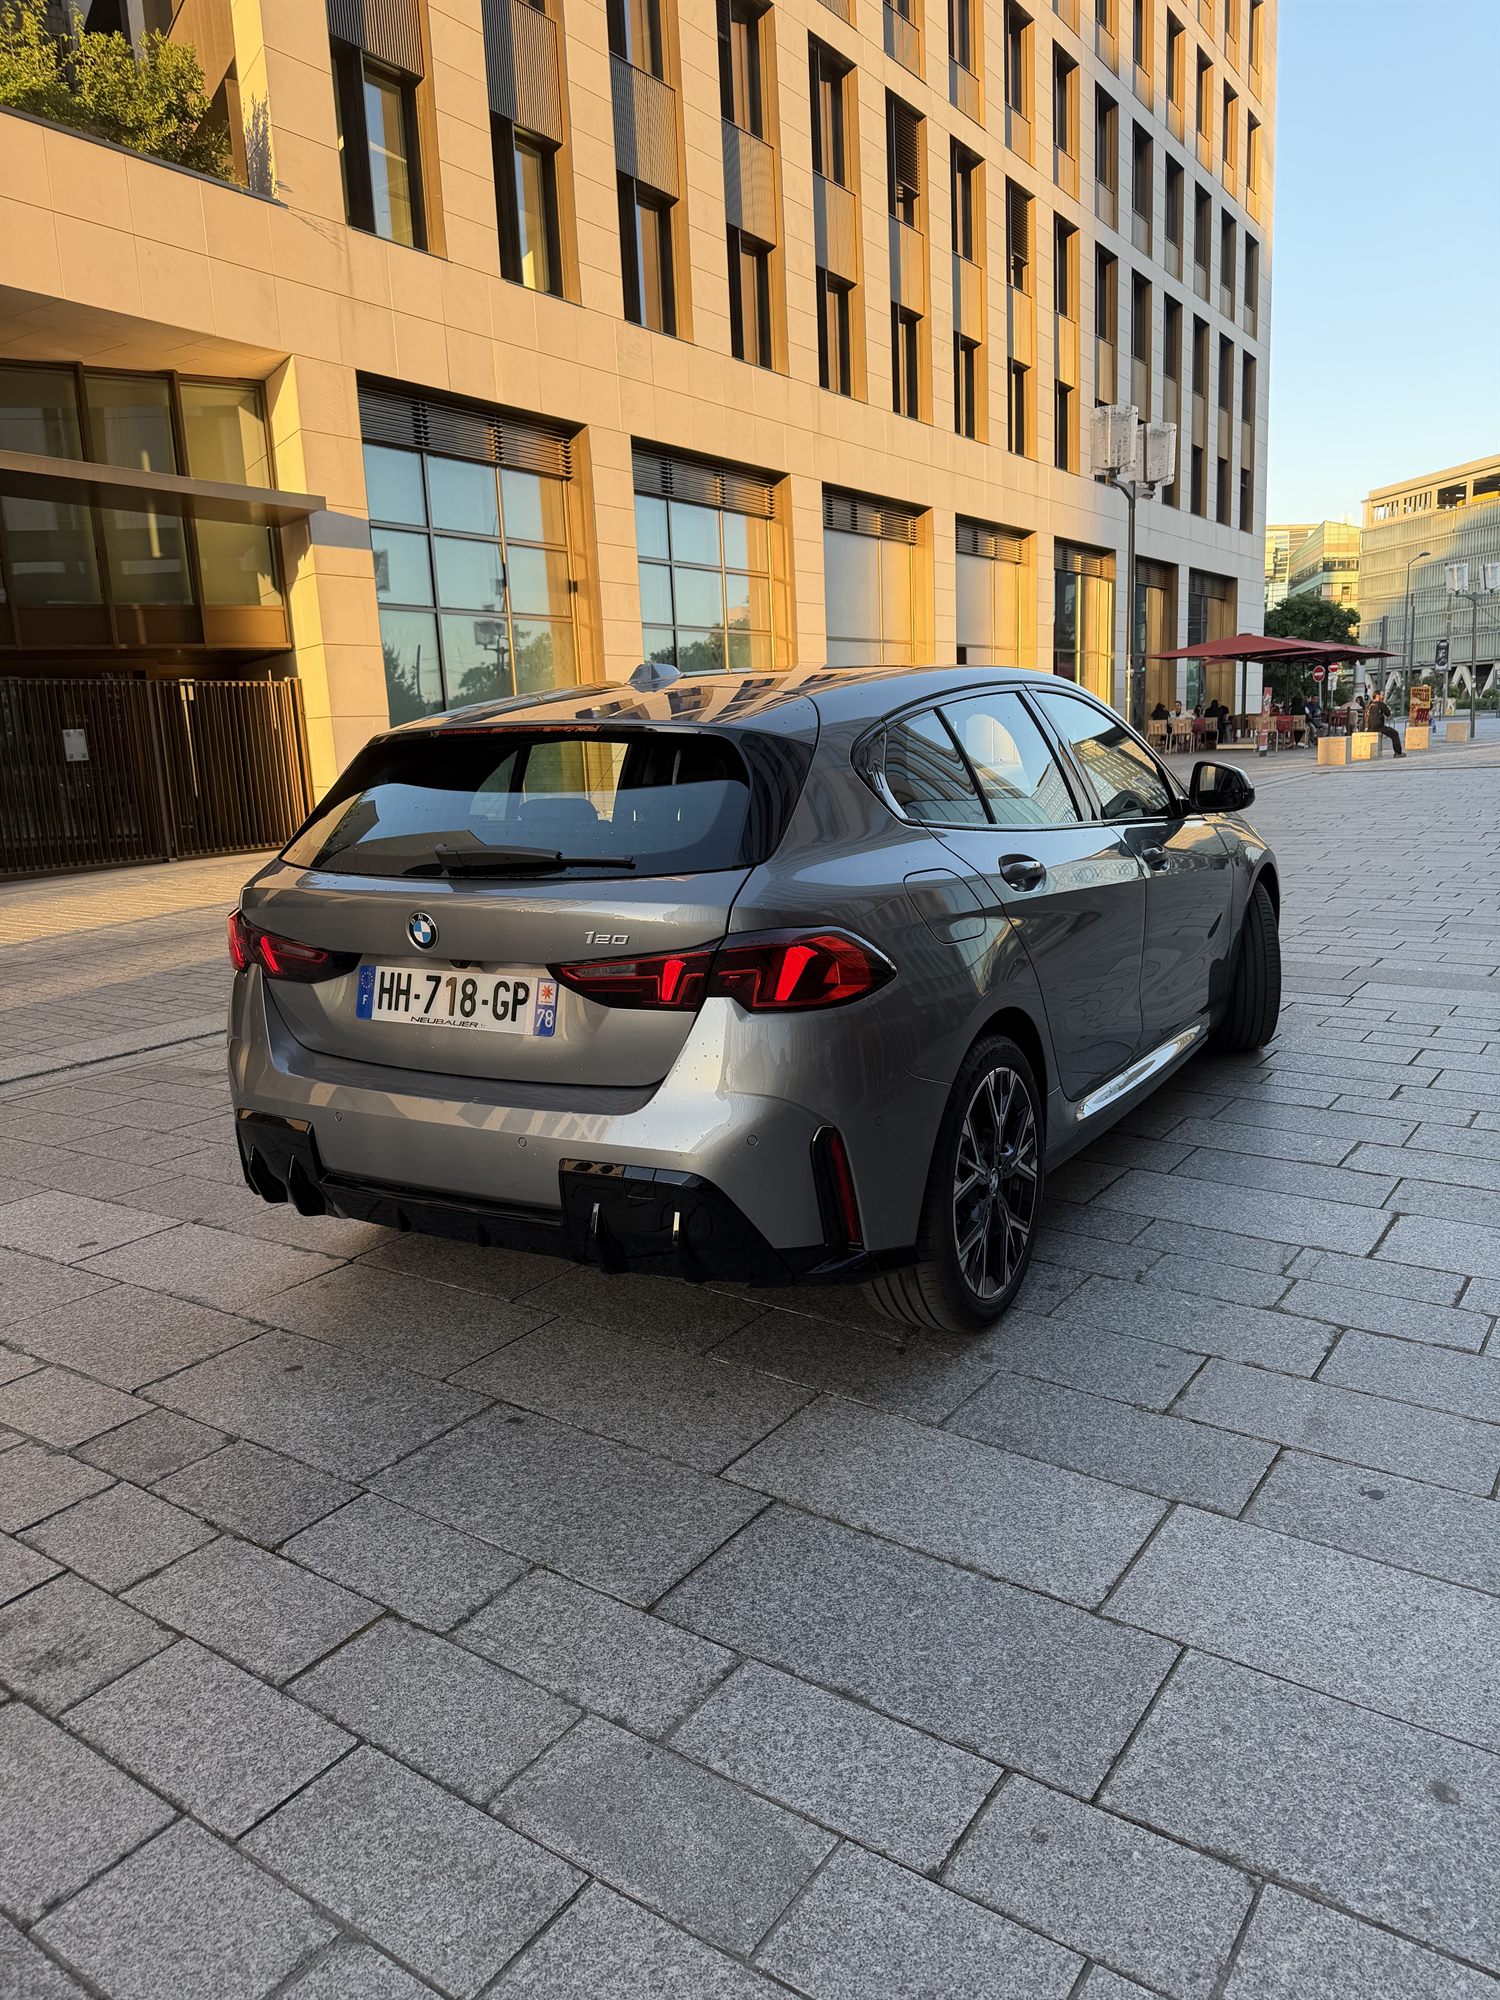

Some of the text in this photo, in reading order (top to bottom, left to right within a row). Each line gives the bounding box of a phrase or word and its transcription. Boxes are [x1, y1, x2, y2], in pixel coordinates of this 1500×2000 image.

[584, 931, 629, 945] 120
[362, 994, 368, 1005] F
[378, 971, 530, 1022] HH-718-GP
[536, 1008, 554, 1028] 78
